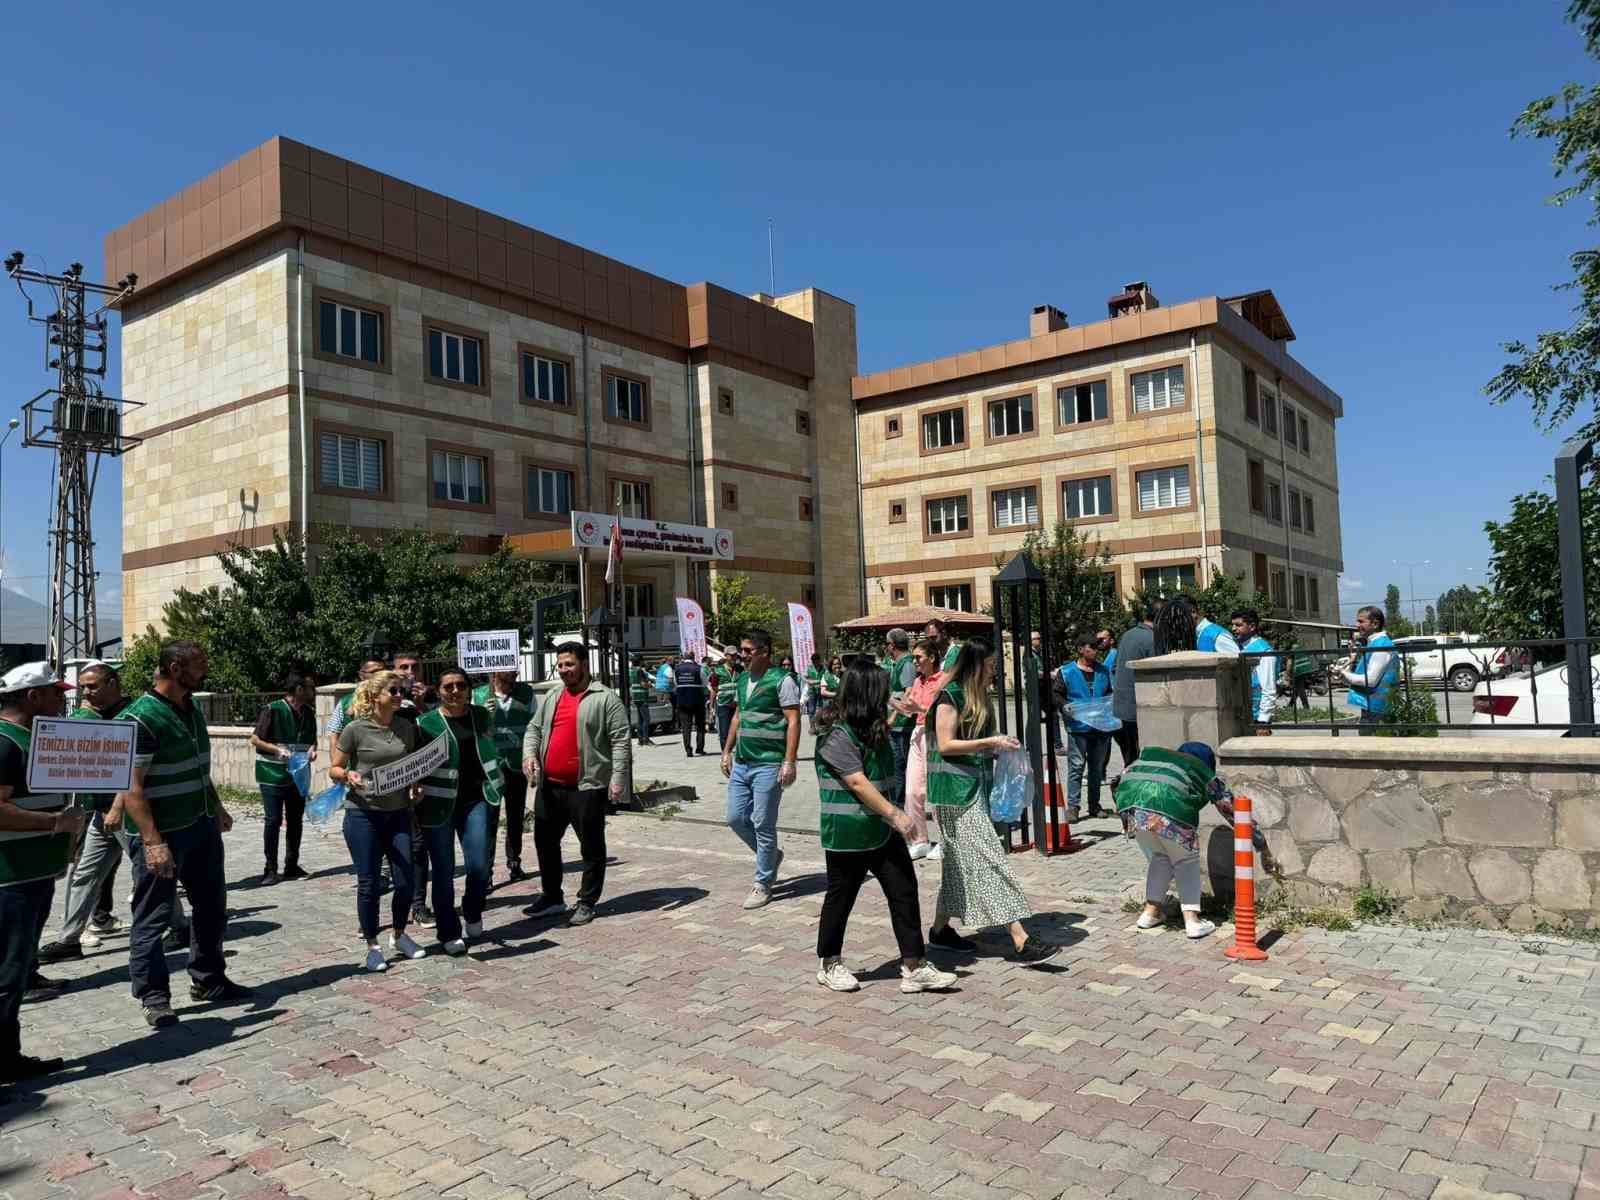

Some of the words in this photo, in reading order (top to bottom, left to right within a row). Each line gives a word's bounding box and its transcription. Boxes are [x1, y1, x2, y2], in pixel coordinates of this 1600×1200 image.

[467, 640, 488, 652] UYGAR
[464, 654, 483, 668] TEMİZ
[484, 652, 516, 668] İNSANDIR
[38, 736, 74, 752] TEMİZLİK
